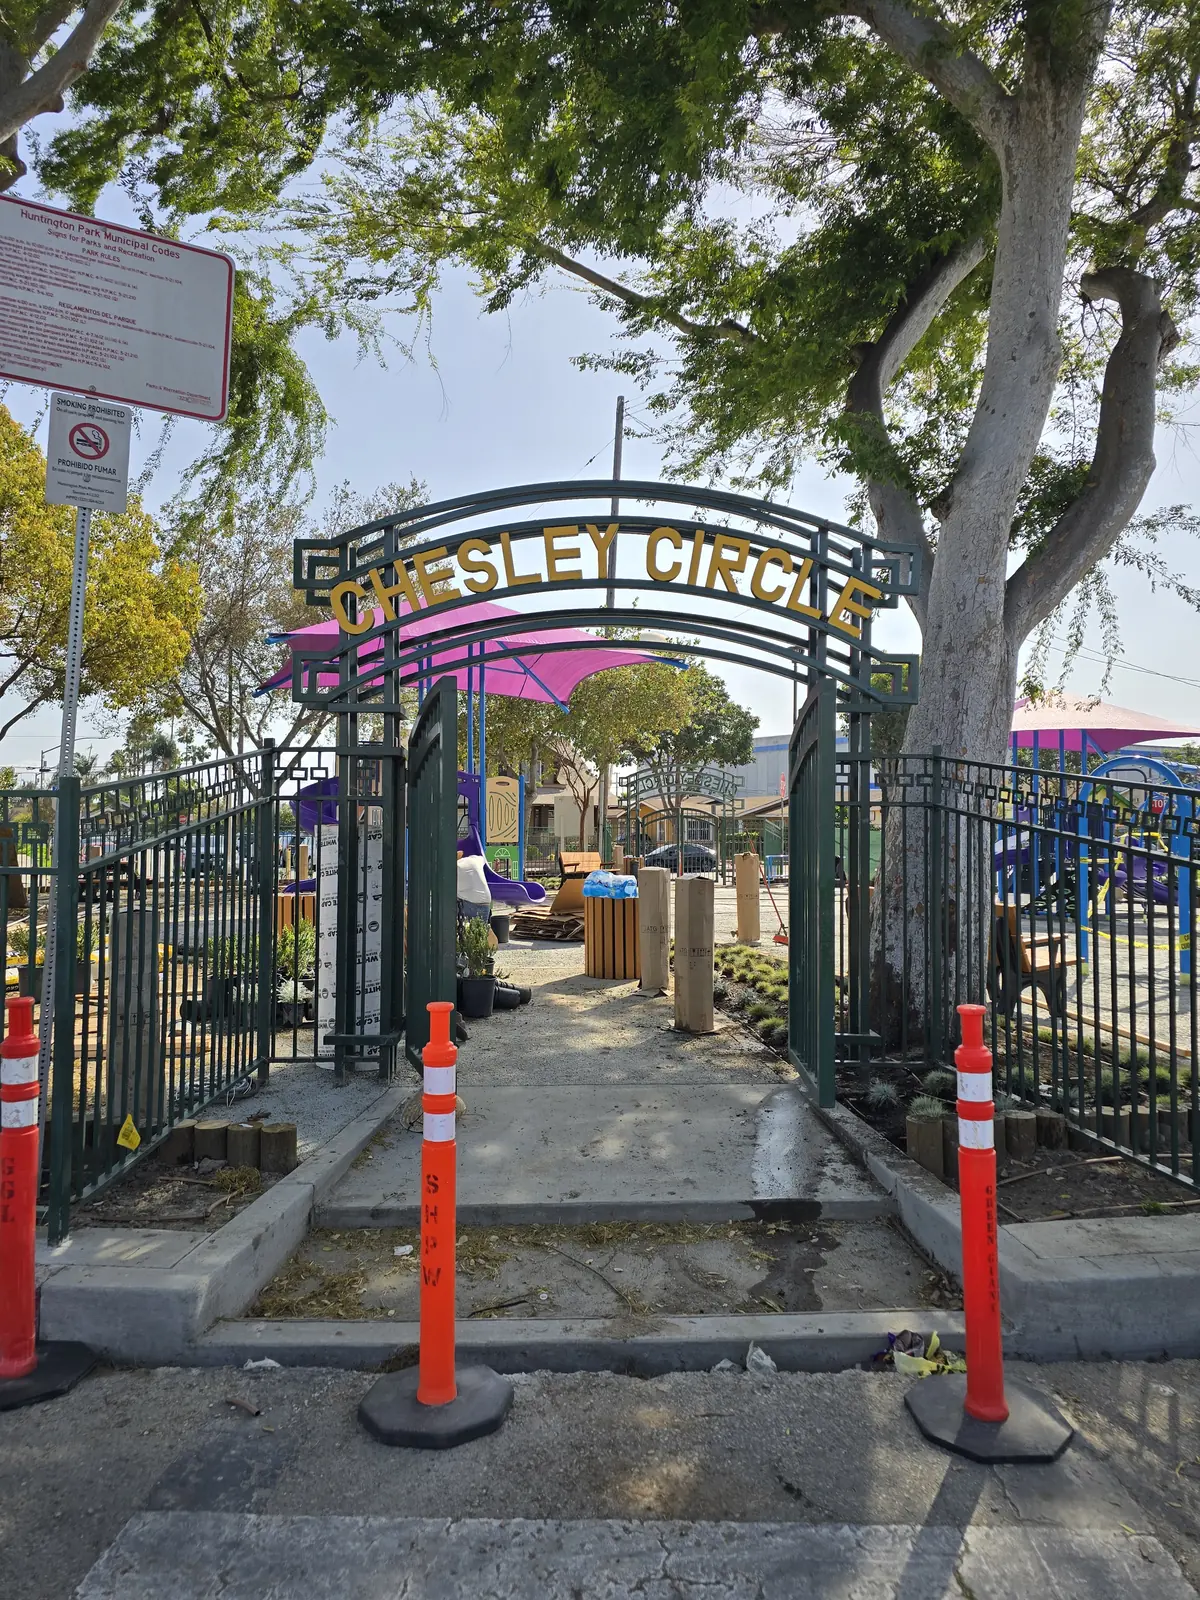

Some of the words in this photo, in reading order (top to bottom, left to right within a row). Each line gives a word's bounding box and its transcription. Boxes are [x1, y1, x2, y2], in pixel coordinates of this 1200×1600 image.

[20, 208, 75, 231] Huntington
[78, 223, 101, 238] Park
[104, 231, 149, 252] Municipal
[151, 244, 180, 260] Codes
[47, 228, 66, 240] Signs
[69, 234, 78, 242] for
[81, 237, 101, 248] Parks
[103, 242, 115, 252] and
[118, 246, 154, 262] Recreation
[81, 247, 98, 257] PARK
[100, 252, 120, 262] RULES
[58, 301, 100, 316] REGLAMENTOS
[101, 311, 112, 319] DEL
[113, 314, 136, 325] PARQUE
[56, 397, 86, 410] SMOKING
[88, 403, 125, 418] PROHIBITED
[57, 458, 93, 471] PROHIBIDO
[94, 464, 116, 475] FUMAR
[329, 522, 620, 637] CHESLEY
[646, 526, 884, 638] CIRCLE
